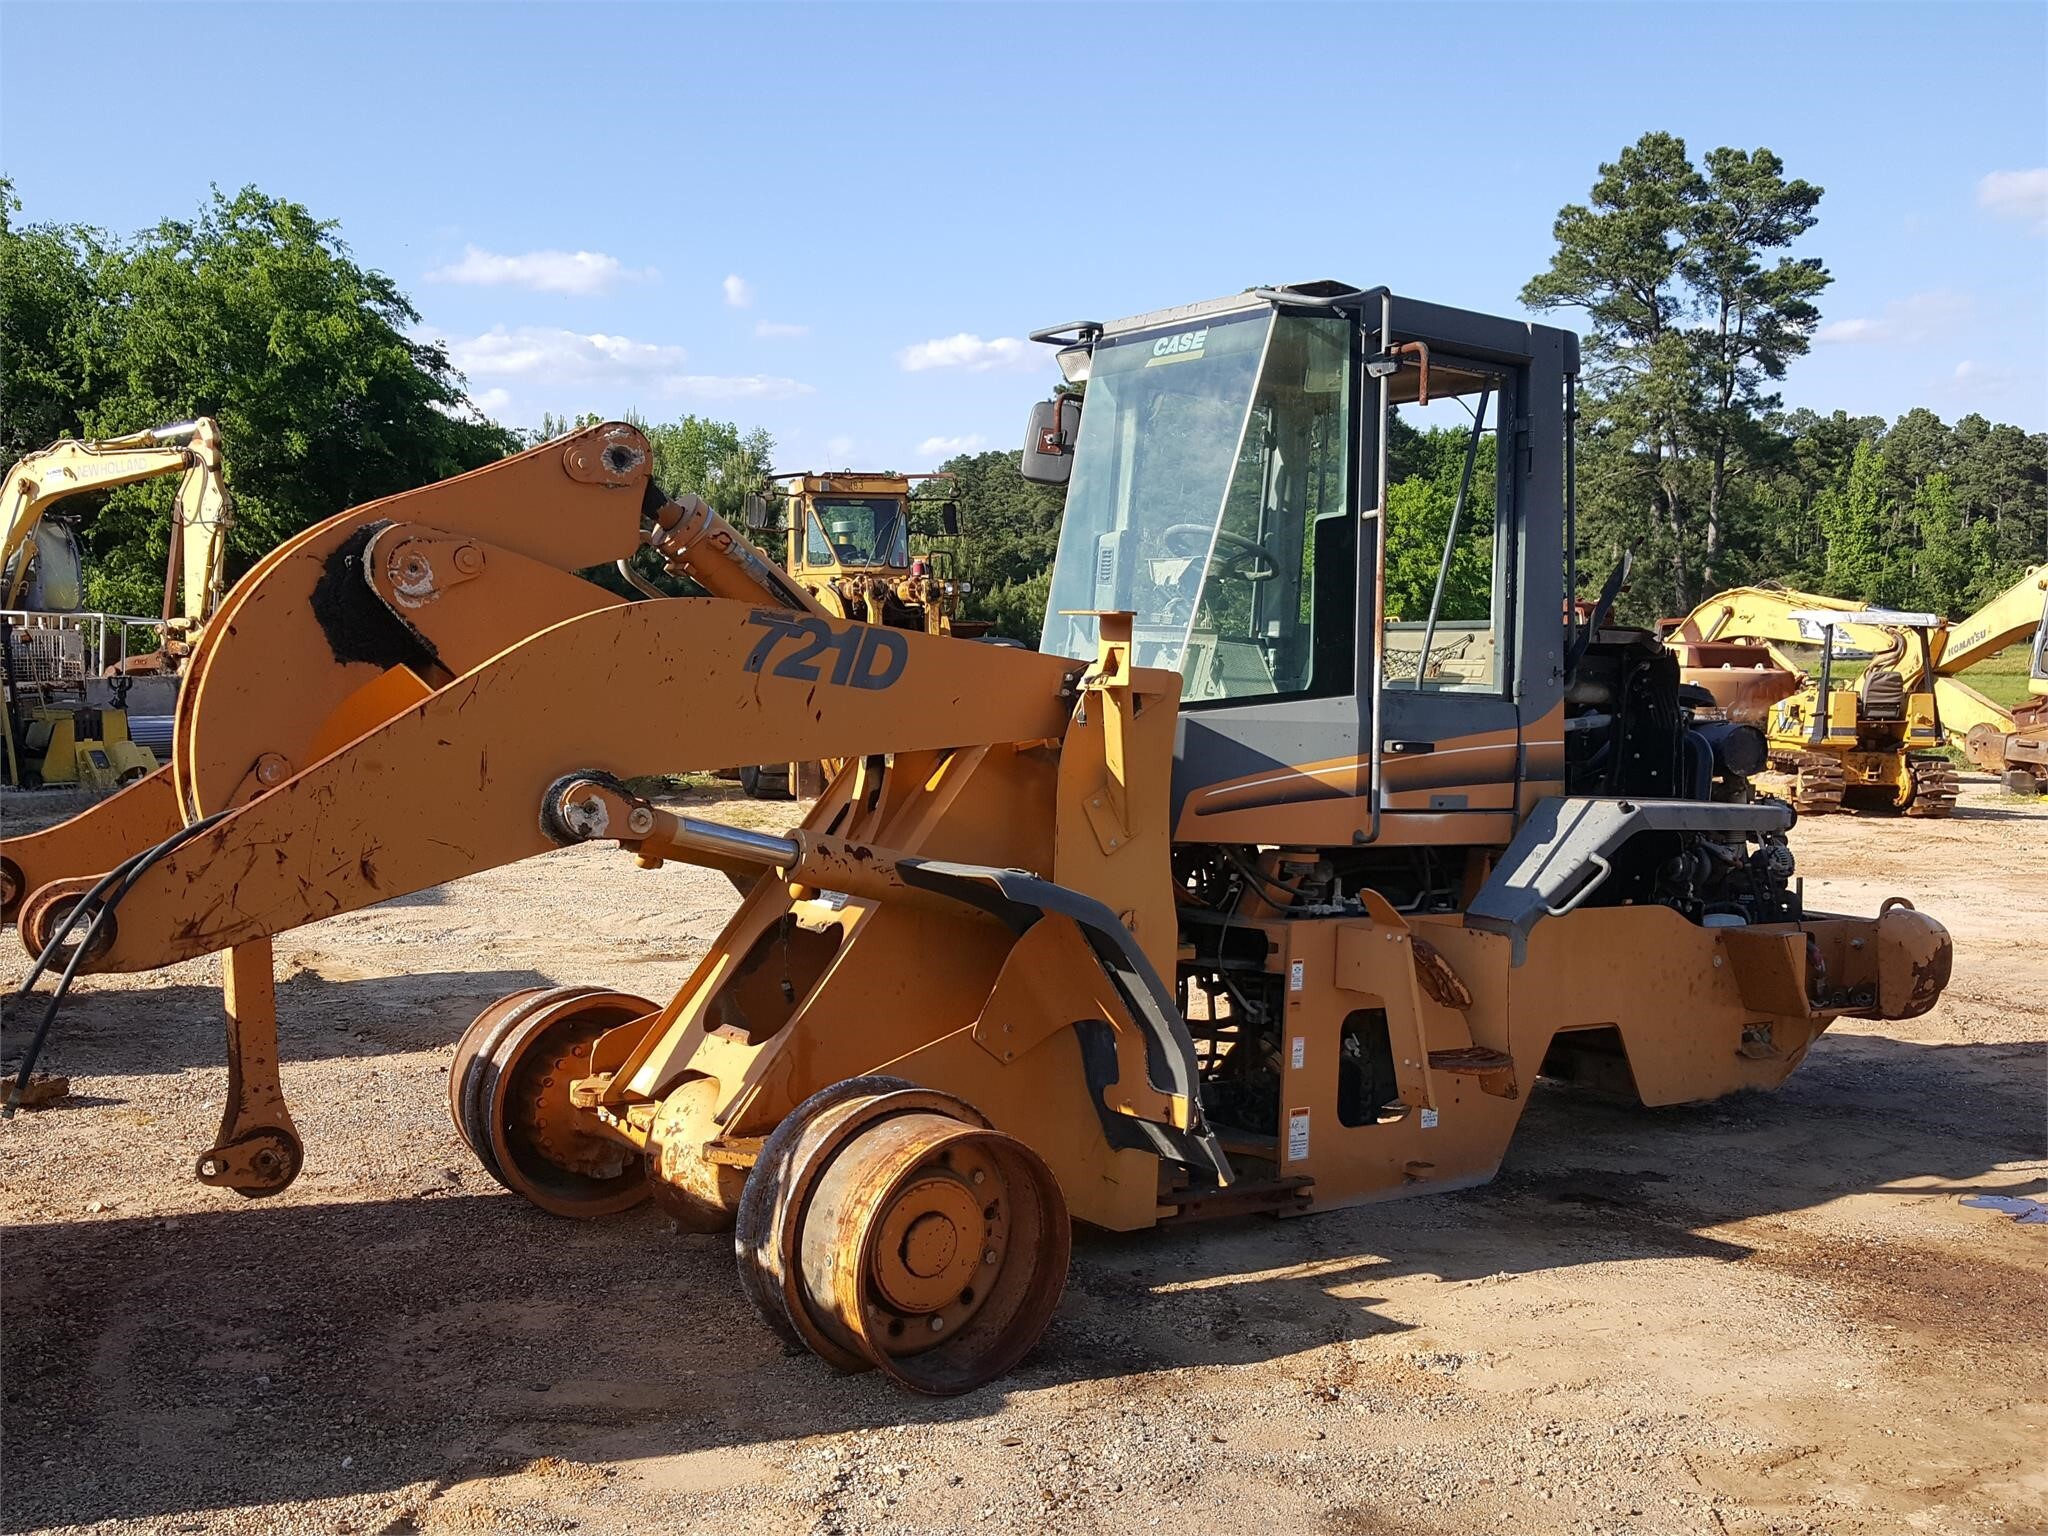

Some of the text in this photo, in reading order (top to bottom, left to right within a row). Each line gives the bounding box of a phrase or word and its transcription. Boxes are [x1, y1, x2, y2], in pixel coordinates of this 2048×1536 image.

[1153, 330, 1207, 356] CASE
[100, 458, 147, 476] HOLLAND
[743, 610, 908, 690] 721D
[1948, 629, 1986, 656] KOMATSU
